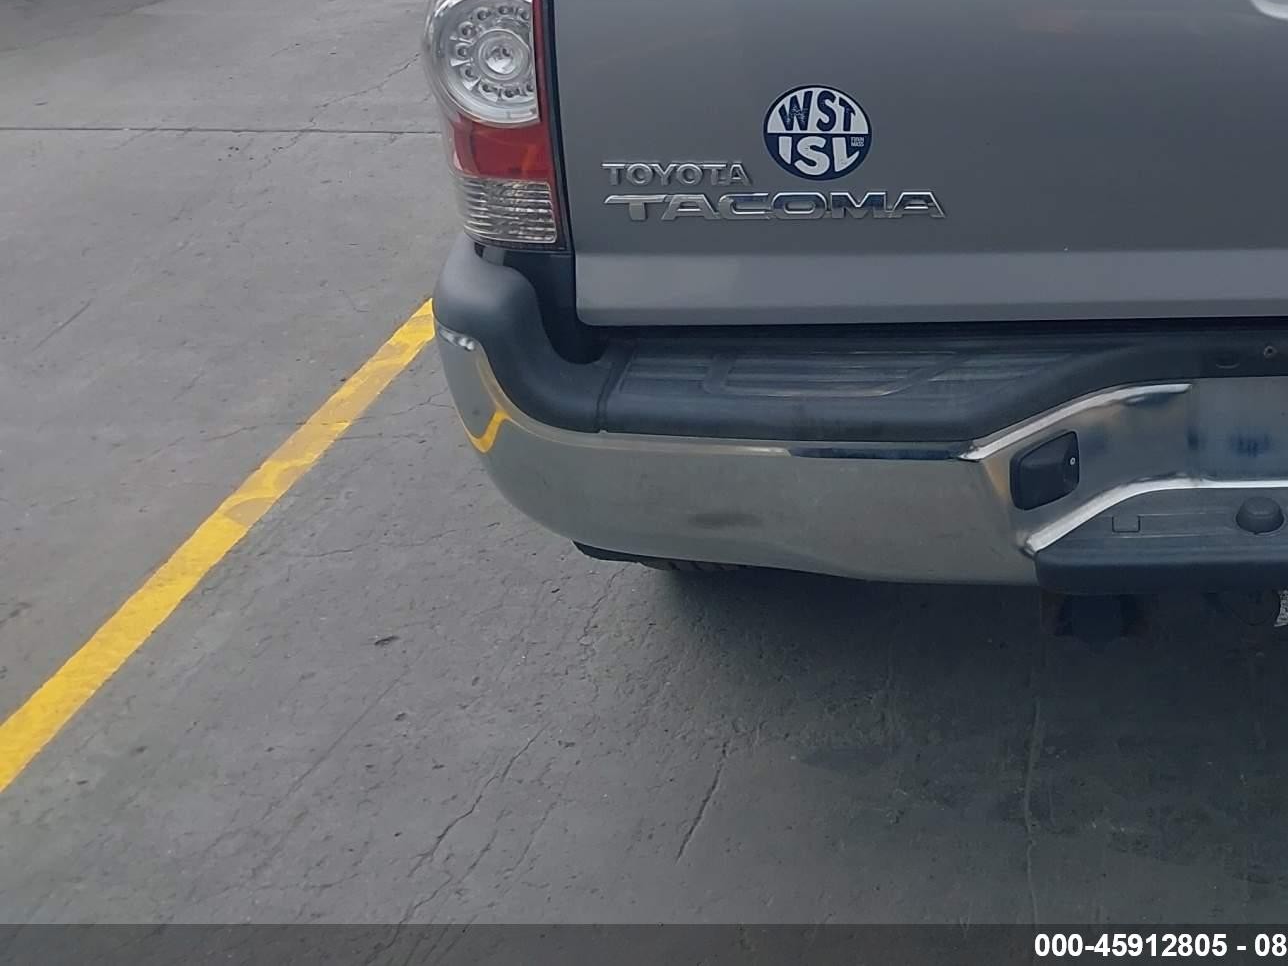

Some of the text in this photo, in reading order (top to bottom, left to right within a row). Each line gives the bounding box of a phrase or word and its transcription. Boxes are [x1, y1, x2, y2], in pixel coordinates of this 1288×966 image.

[778, 90, 857, 132] WST
[601, 161, 754, 186] TOYOTA
[778, 135, 860, 176] ISL
[604, 190, 947, 221] TACOMA
